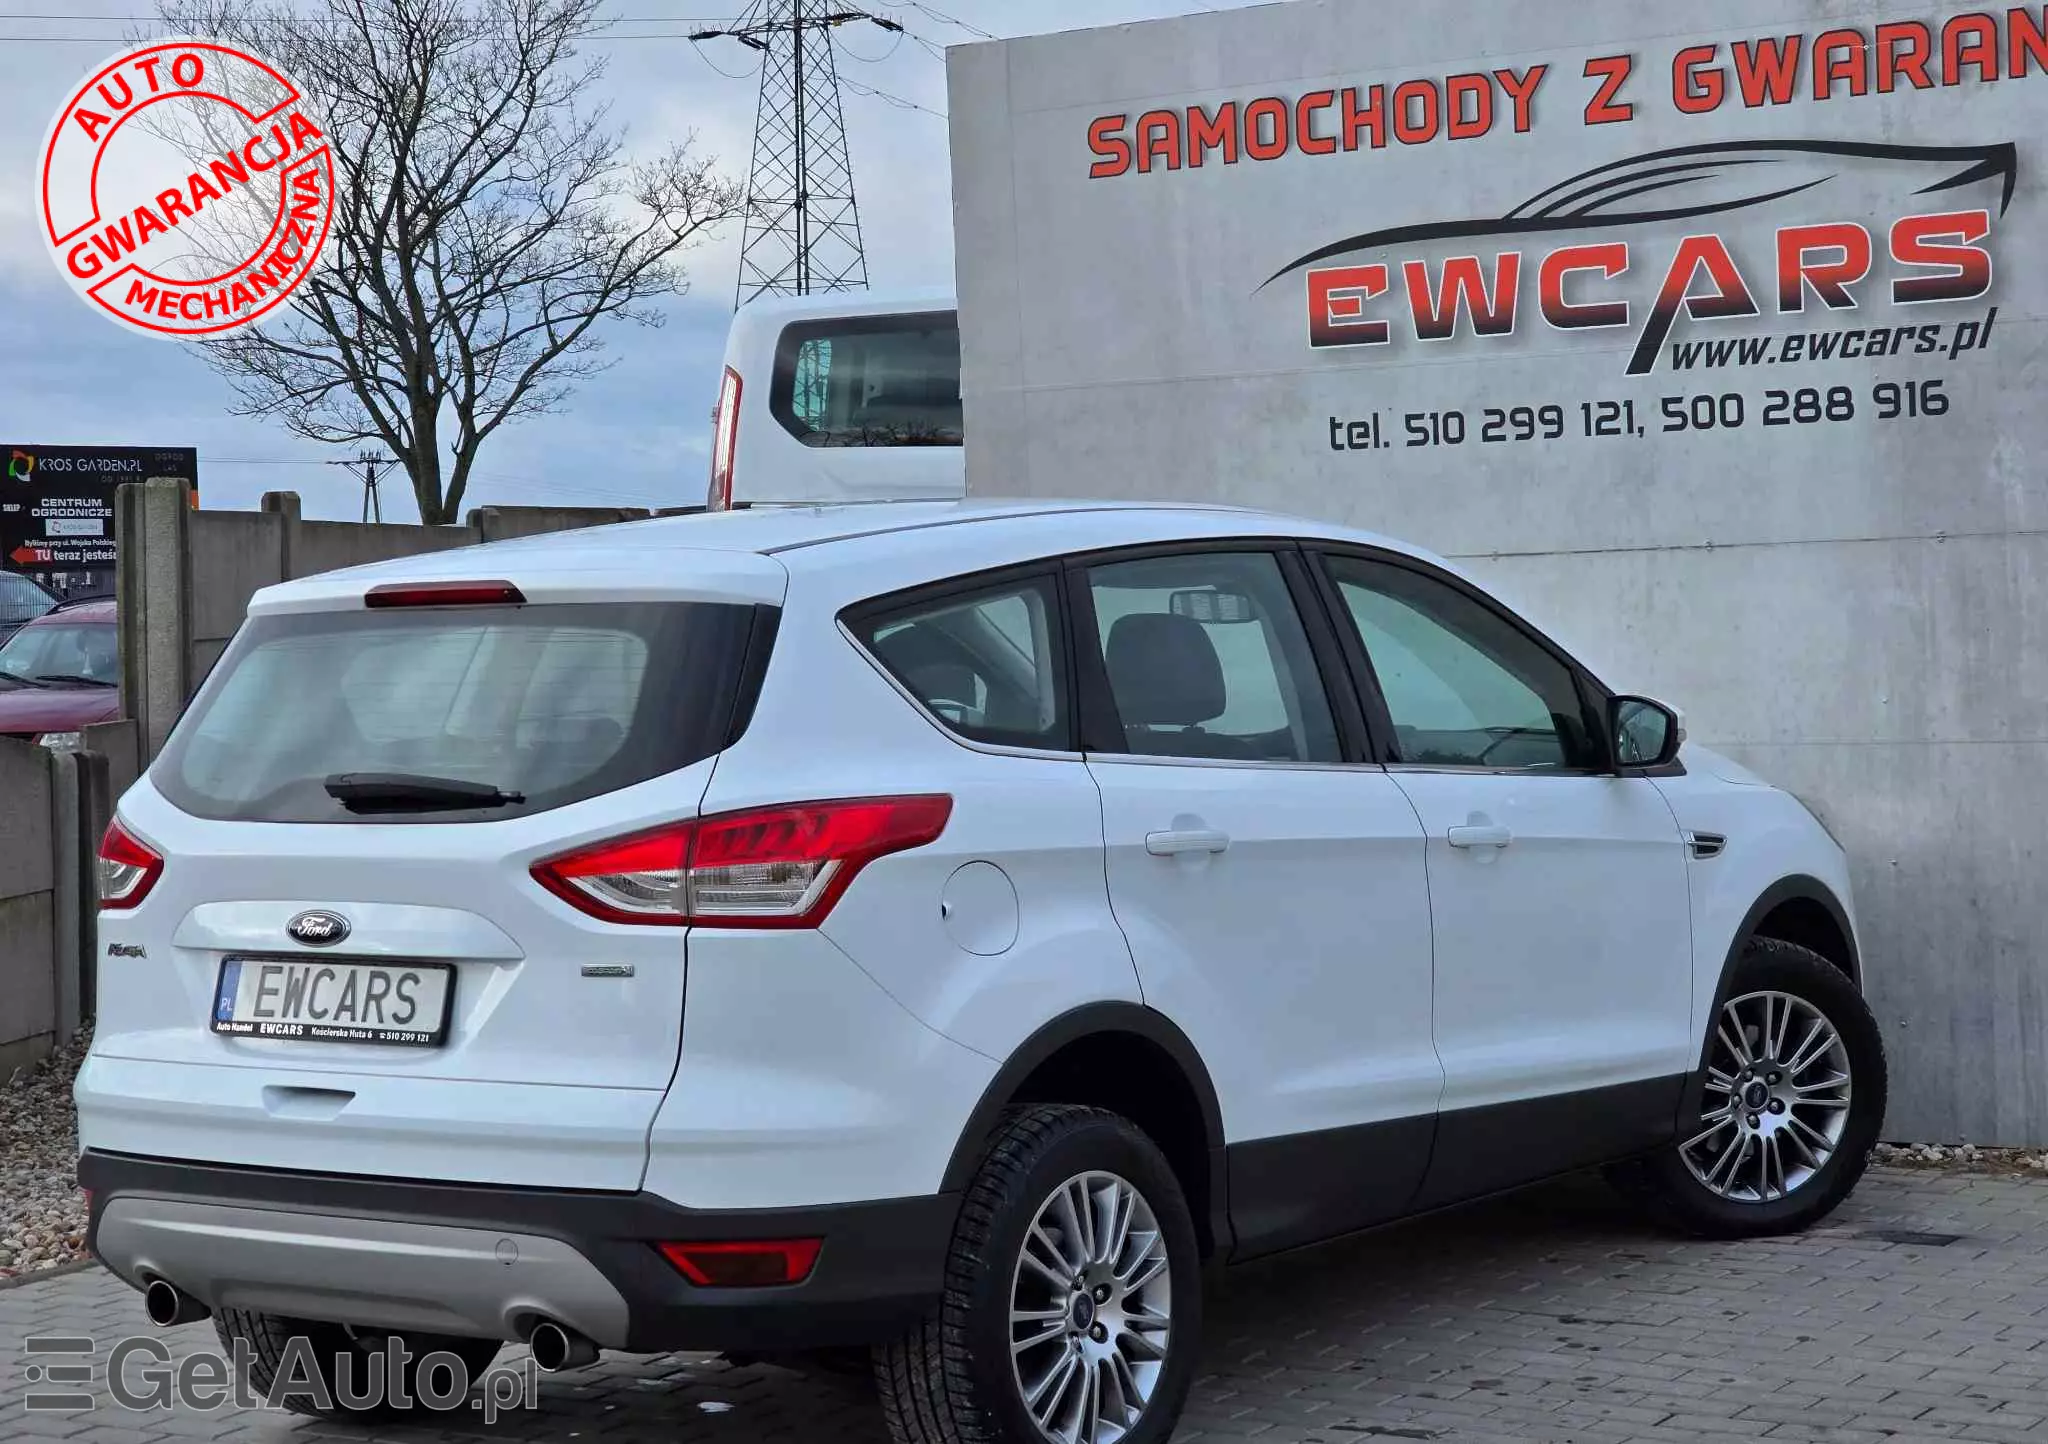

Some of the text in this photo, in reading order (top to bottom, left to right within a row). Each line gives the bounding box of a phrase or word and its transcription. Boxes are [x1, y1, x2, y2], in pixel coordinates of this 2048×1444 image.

[1089, 4, 2048, 179] SAMOCHODY Z GWARAN
[1305, 208, 1994, 376] EWCARS
[1671, 307, 1998, 372] www.ewcars.pl
[1330, 379, 1950, 451] tel. 510 299 121, 500 288 916
[39, 458, 143, 473] KROS GARDEN.PL
[31, 508, 113, 517] OGRODNICZE
[41, 498, 102, 507] CENTRUM
[35, 549, 51, 561] TU
[54, 550, 80, 561] teraz
[296, 916, 334, 938] Ford
[220, 997, 233, 1012] PL
[253, 965, 422, 1025] EWCARS
[217, 1022, 231, 1031] Auto
[231, 1023, 253, 1032] Handel
[260, 1023, 304, 1035] EWCARS
[350, 1029, 366, 1038] Huta
[367, 1030, 373, 1038] 6
[386, 1032, 399, 1041] 510
[401, 1032, 415, 1042] 299
[417, 1033, 429, 1043] 121
